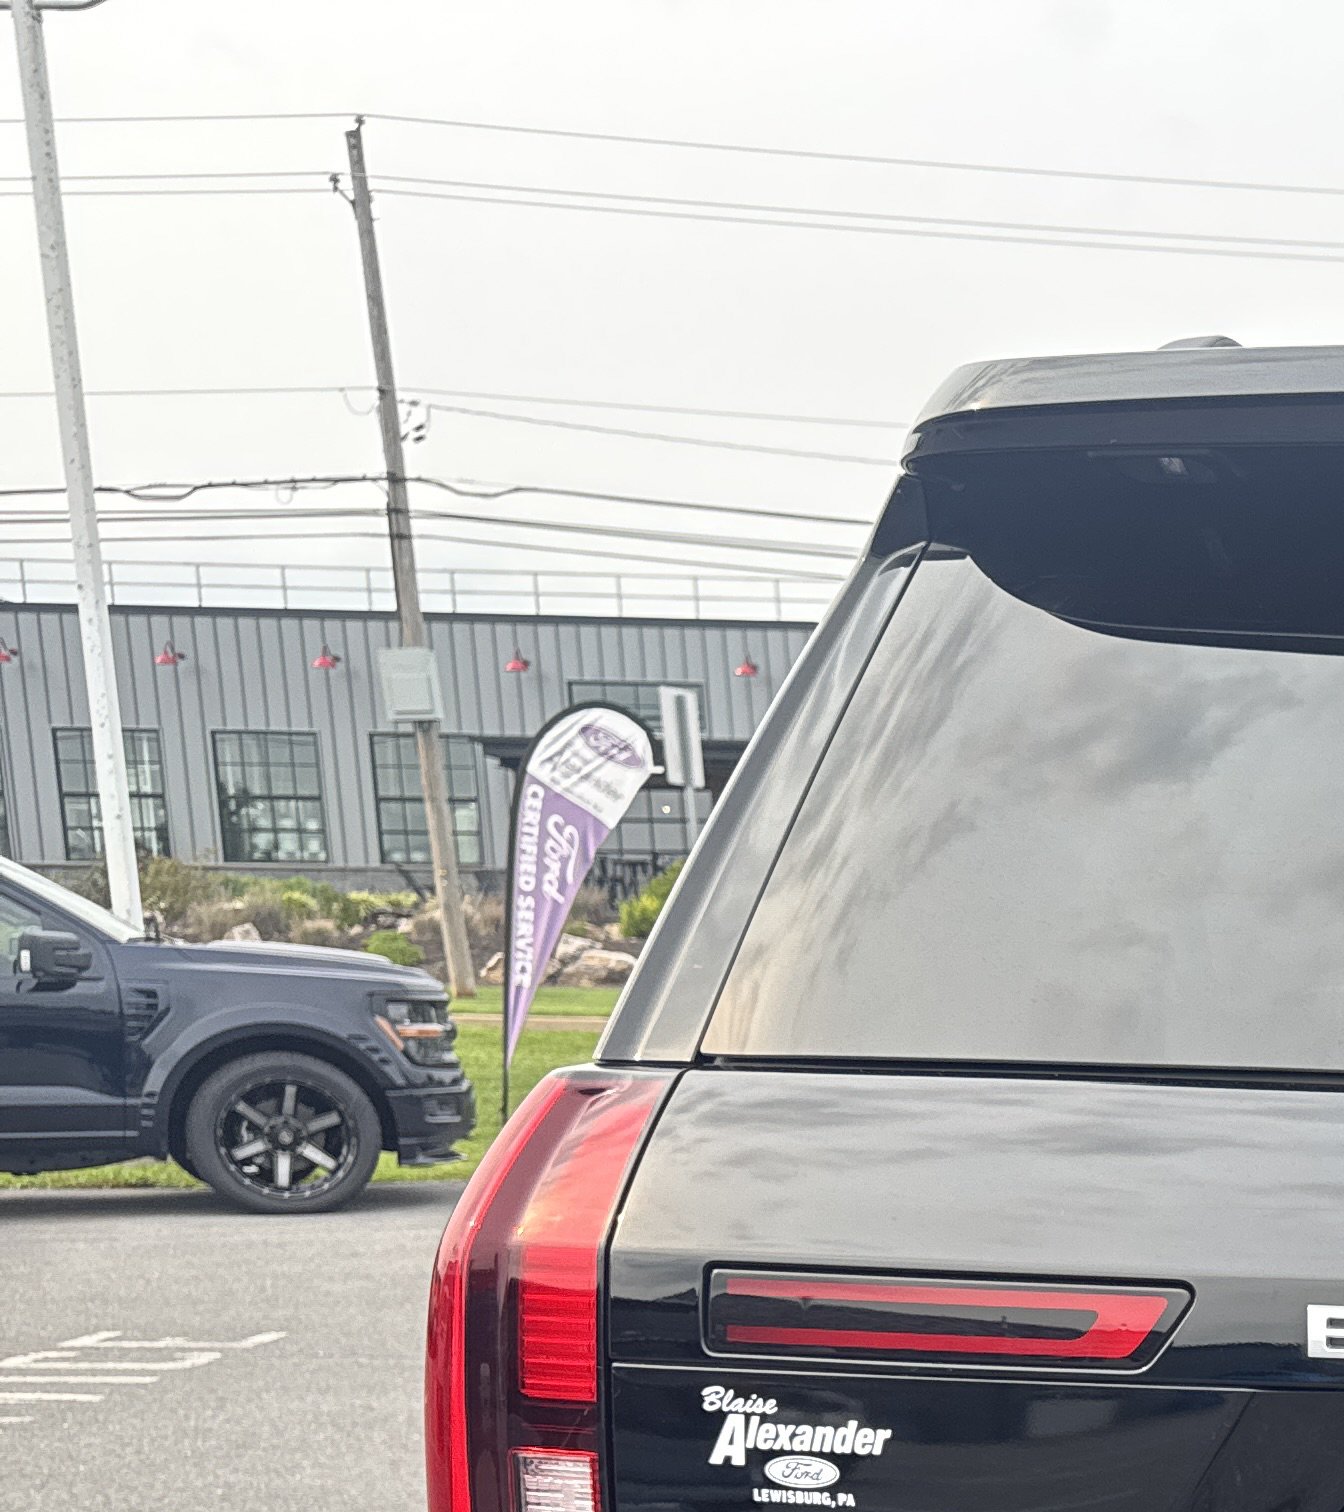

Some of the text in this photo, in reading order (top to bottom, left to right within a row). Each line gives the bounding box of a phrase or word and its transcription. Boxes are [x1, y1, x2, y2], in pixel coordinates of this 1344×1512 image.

[514, 783, 545, 989] CERTIFIED SERVICE
[541, 813, 580, 905] Ford
[700, 1385, 778, 1415] Blaise
[708, 1413, 893, 1467] Alexander
[781, 1461, 824, 1481] Ford
